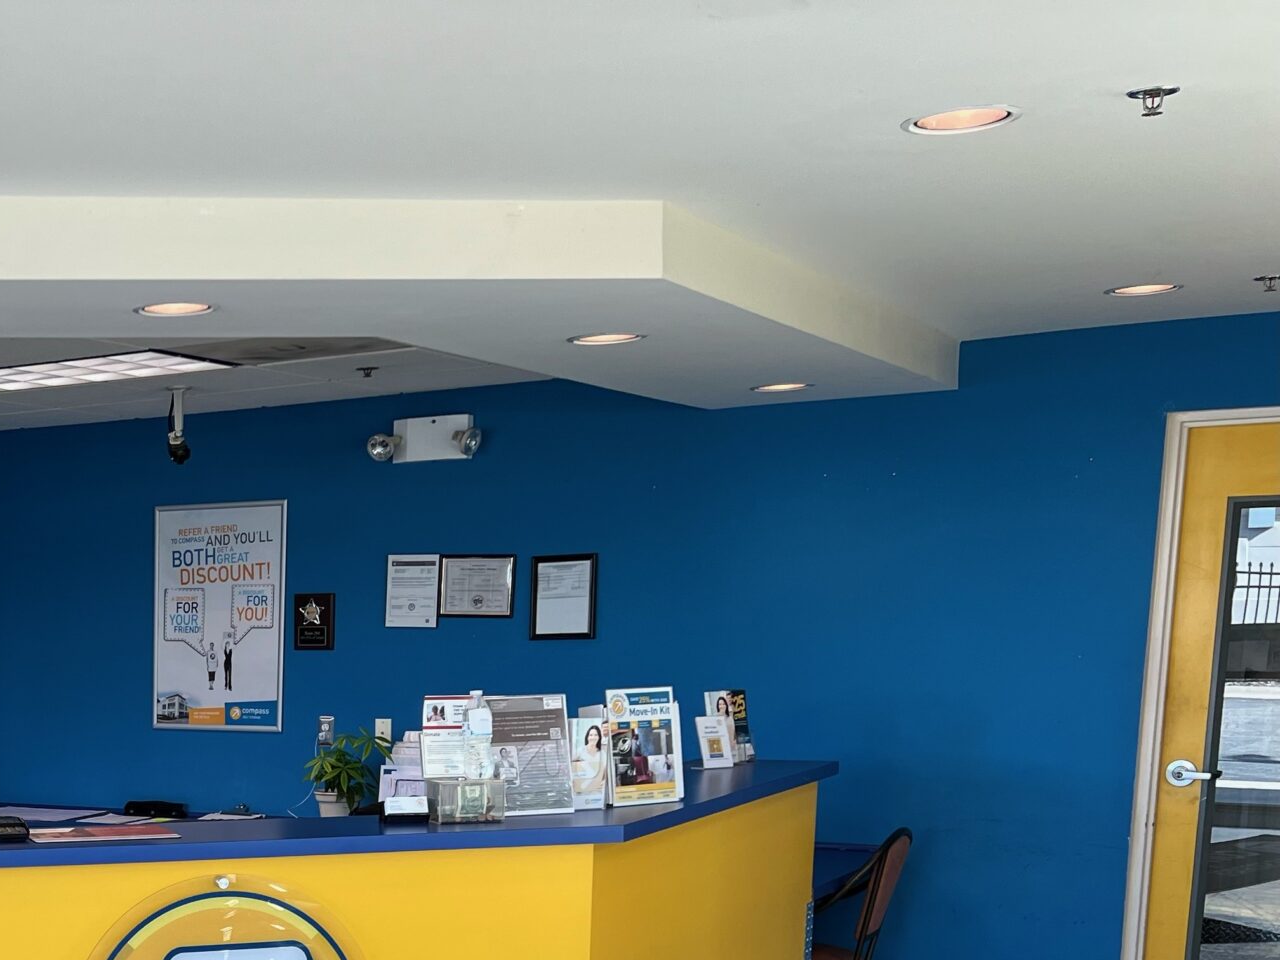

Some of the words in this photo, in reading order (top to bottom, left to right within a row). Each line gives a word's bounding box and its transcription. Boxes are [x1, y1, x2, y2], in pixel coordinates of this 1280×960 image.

[178, 527, 202, 536] REFER
[204, 527, 210, 535] A
[210, 524, 238, 534] FRIEND
[178, 536, 205, 544] COMPASS
[206, 534, 231, 547] AND
[234, 530, 273, 544] YOU'LL
[172, 547, 216, 568] BOTH
[216, 552, 250, 564] GREAT
[180, 562, 271, 585] DISCOUNT!
[247, 595, 268, 606] FOR
[176, 602, 199, 614] FOR
[169, 614, 199, 626] YOUR
[236, 607, 268, 622] YOU!
[242, 706, 269, 716] compass
[629, 706, 658, 717] Move-In
[659, 705, 671, 715] Kit
